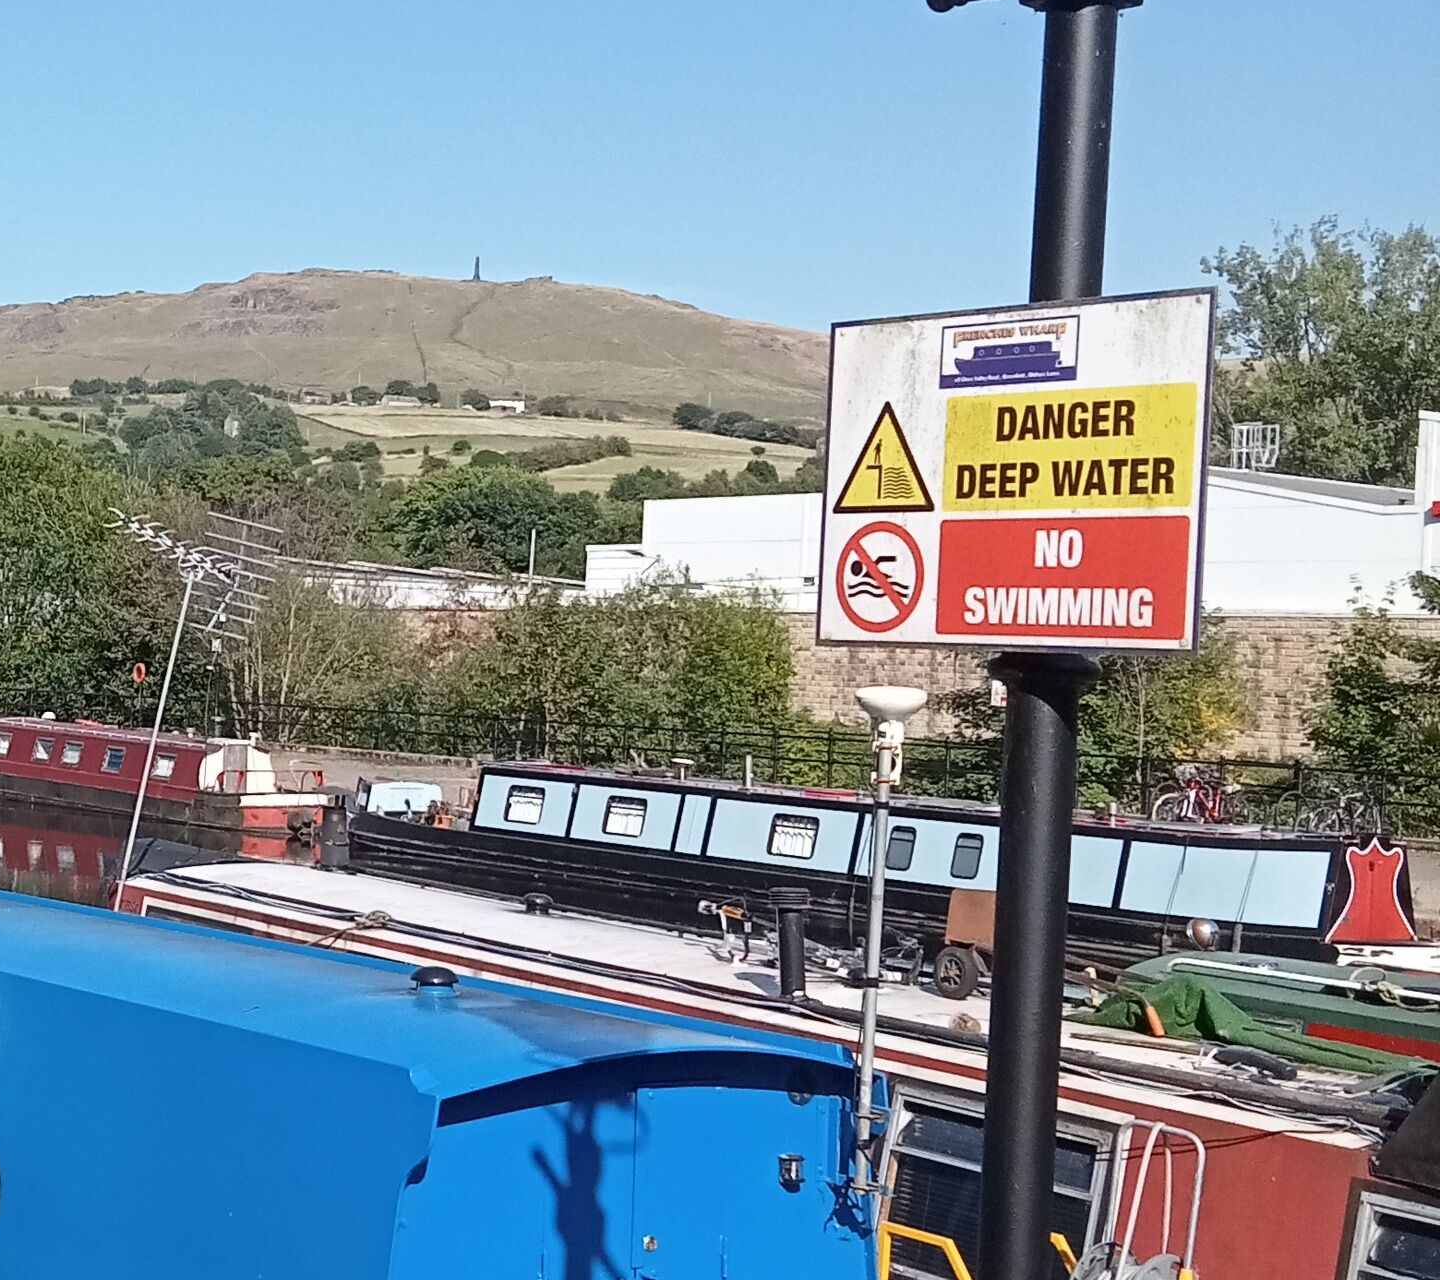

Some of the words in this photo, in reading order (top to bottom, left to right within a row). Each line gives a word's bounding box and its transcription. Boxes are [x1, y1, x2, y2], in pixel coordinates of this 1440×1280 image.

[1019, 323, 1066, 340] WHARF
[996, 400, 1135, 442] DANGER
[955, 463, 1039, 500] DEEP
[1052, 457, 1175, 497] WATER
[1034, 529, 1084, 568] NO
[964, 587, 1153, 628] SWIMMING
